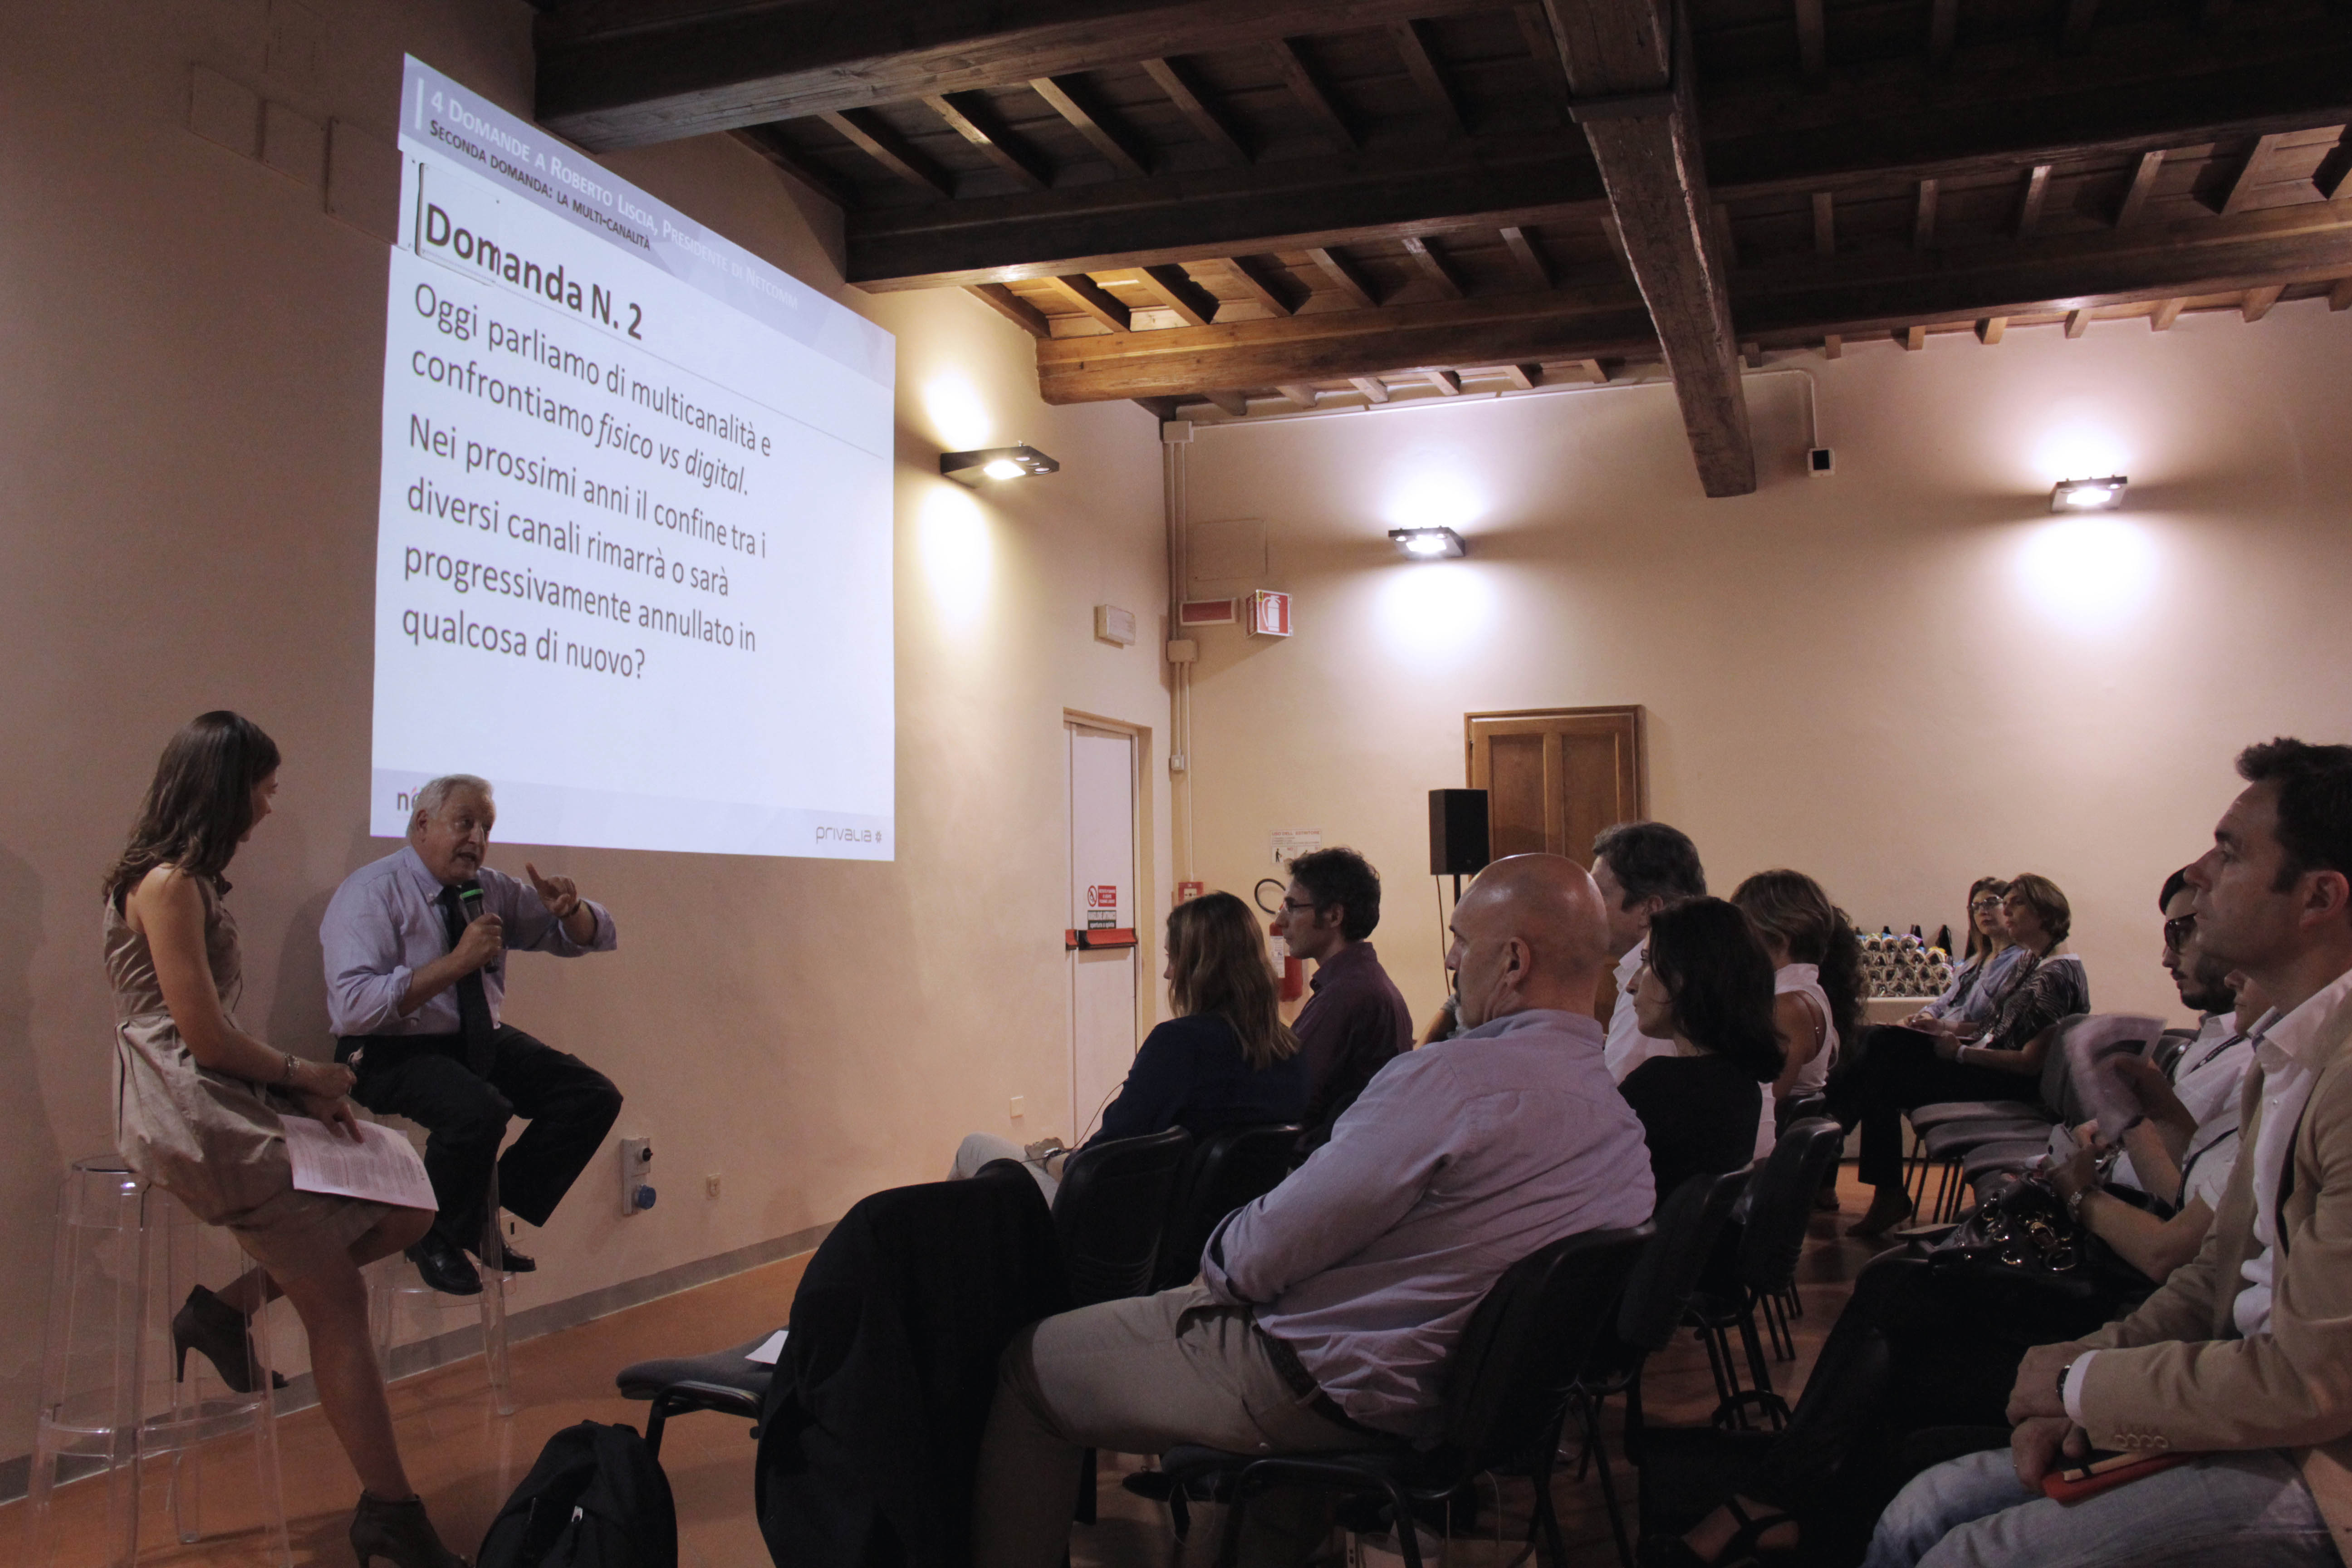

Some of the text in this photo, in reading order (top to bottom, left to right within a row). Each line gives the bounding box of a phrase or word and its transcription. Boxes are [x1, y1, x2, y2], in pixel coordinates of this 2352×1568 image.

[431, 91, 443, 113] 4
[426, 203, 642, 340] Domanda N. 2
[412, 351, 748, 495] confrontiamo fisico vs digital.
[416, 284, 771, 456] Oggi parliamo di multicanalità e
[408, 476, 728, 597] diversi canali rimarrà o sarà
[411, 414, 766, 559] Nei prossimi anni il confine tra i
[403, 609, 645, 679] qualcosa di nuovo?
[405, 546, 755, 652] progressivamente annullato in
